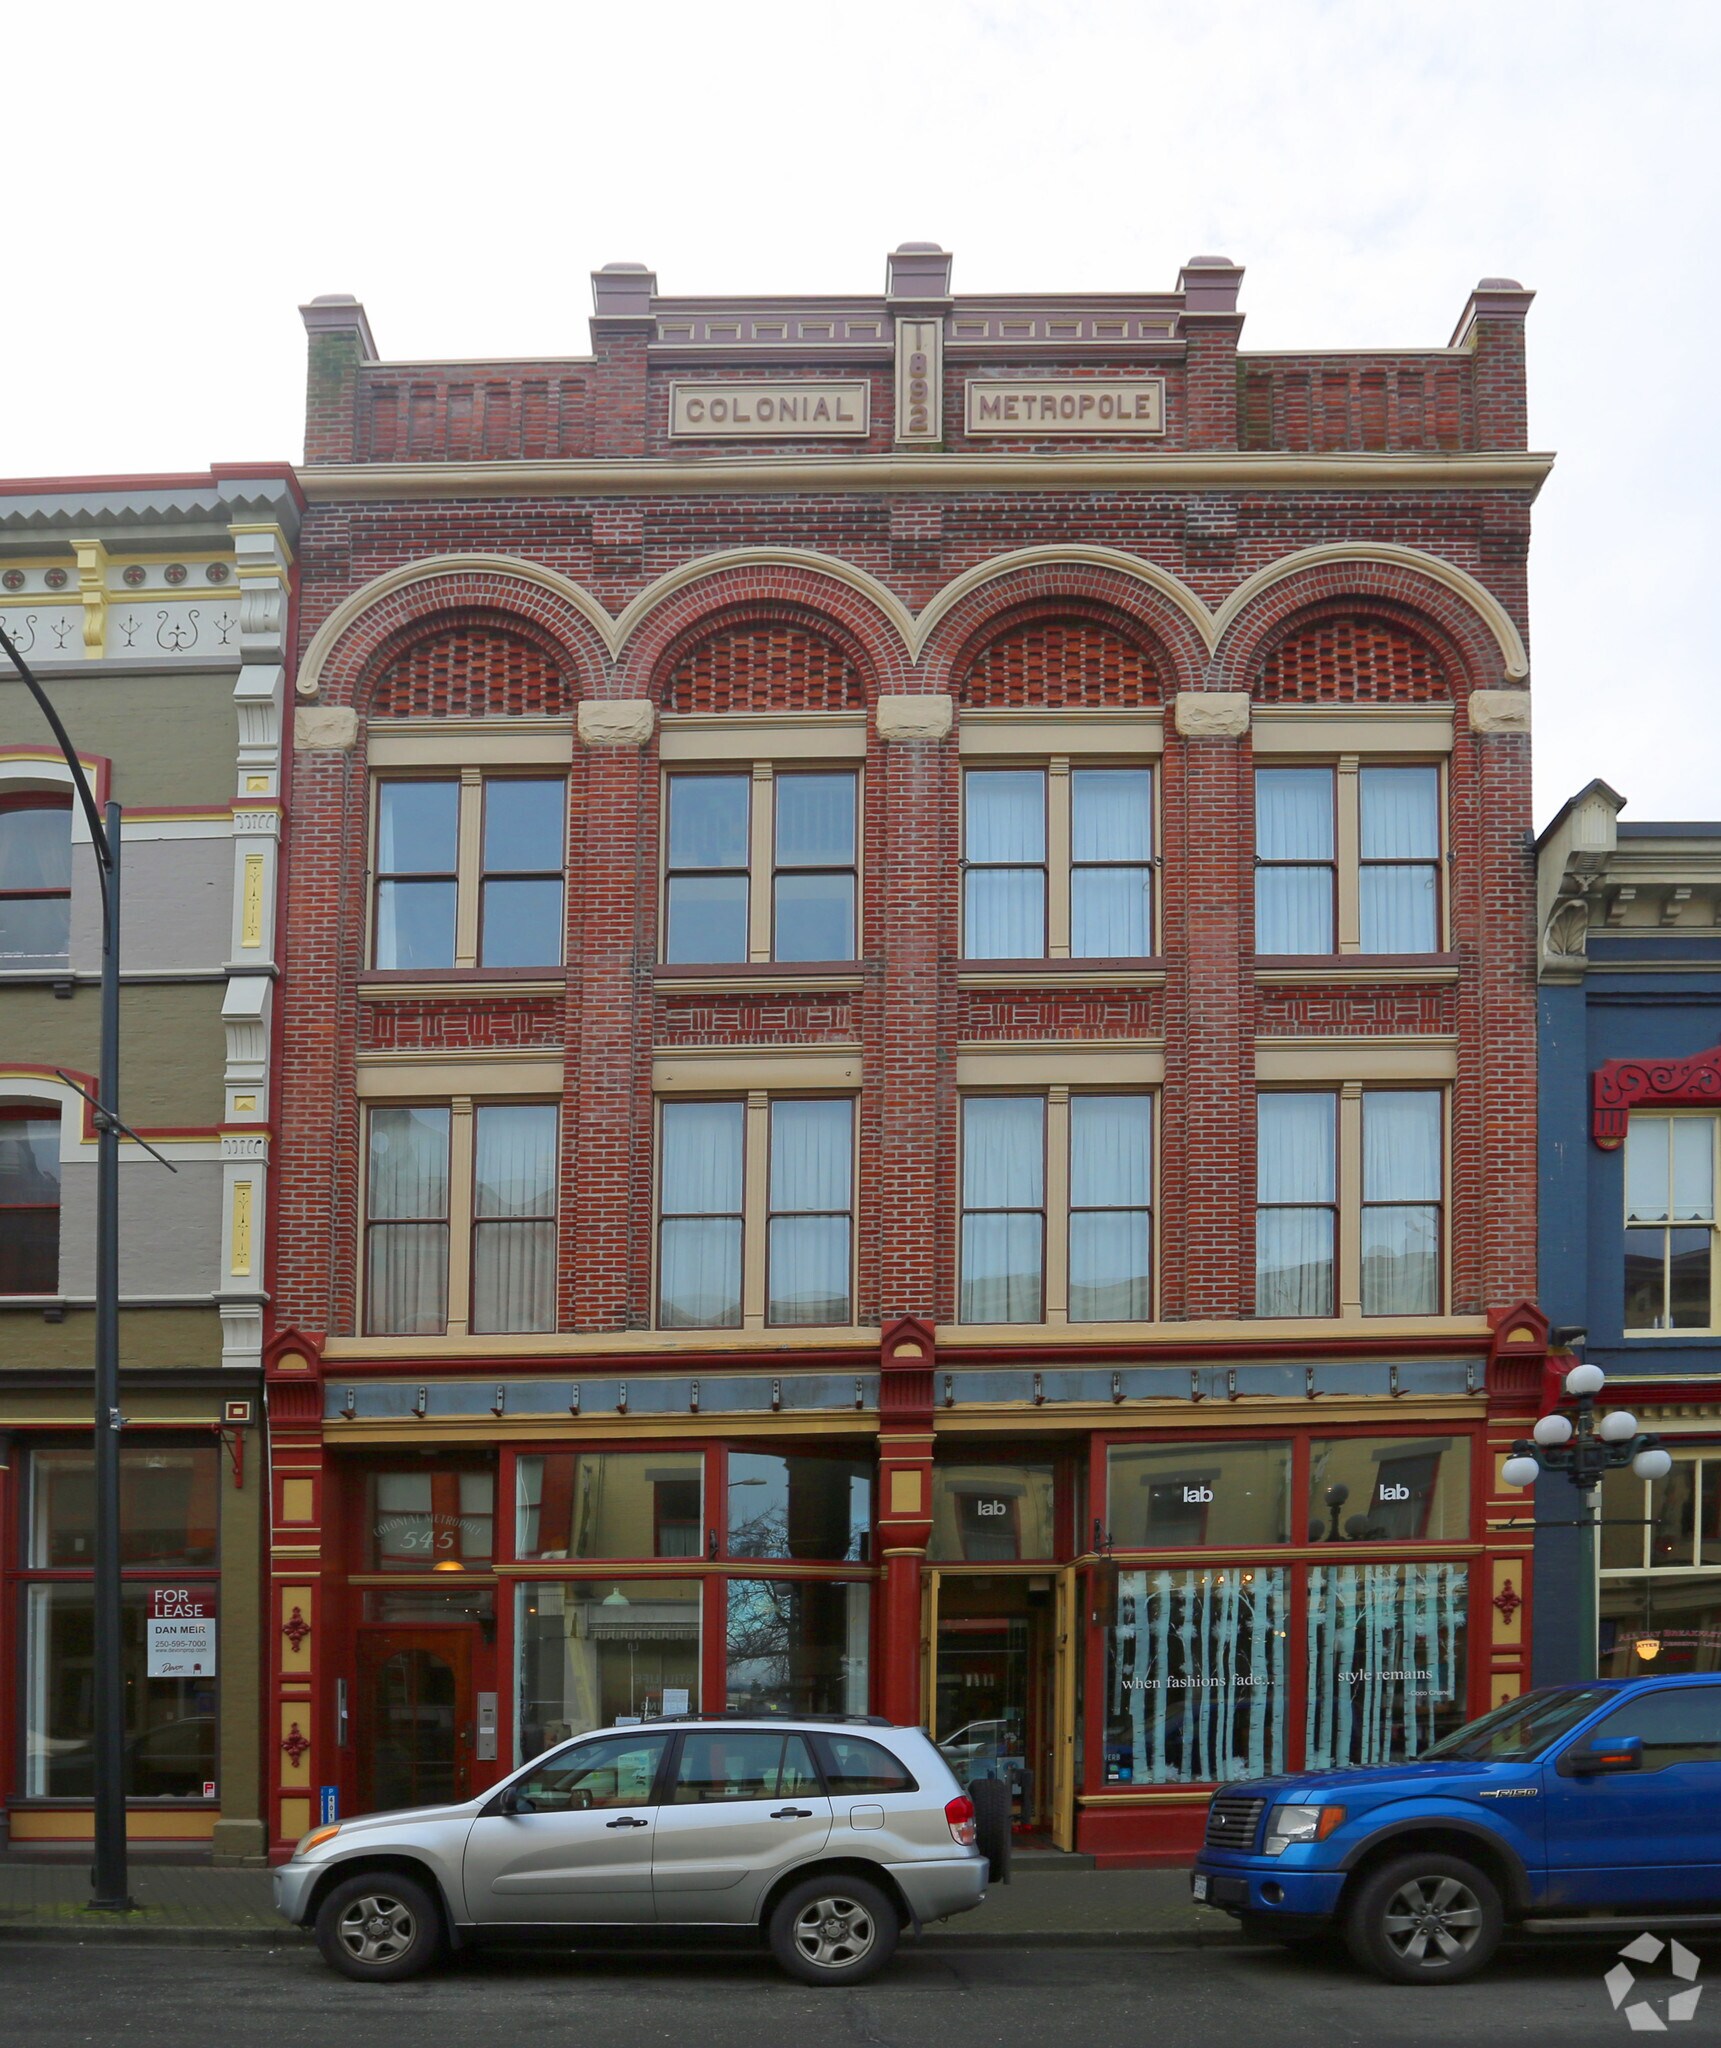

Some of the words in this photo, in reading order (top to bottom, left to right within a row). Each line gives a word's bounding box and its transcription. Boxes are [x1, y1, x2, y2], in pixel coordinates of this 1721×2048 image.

[908, 321, 929, 432] 1892
[685, 397, 854, 424] COLONIAL
[979, 393, 1151, 420] METROPOLE
[1183, 1485, 1214, 1503] lab
[1379, 1484, 1410, 1501] lab
[977, 1500, 1006, 1516] lab
[372, 1513, 423, 1538] COLONIAL
[424, 1513, 484, 1537] METROPOLE
[399, 1530, 455, 1549] 545
[154, 1589, 189, 1603] FOR
[154, 1604, 204, 1618] LEASE
[155, 1626, 177, 1634] DAN
[180, 1626, 206, 1634] MEIR
[155, 1640, 207, 1648] 250-595-7000
[1122, 1676, 1161, 1689] when
[1166, 1674, 1226, 1688] fashions
[1231, 1673, 1275, 1686] fade...
[1338, 1668, 1372, 1684] style
[1374, 1669, 1433, 1681] remains
